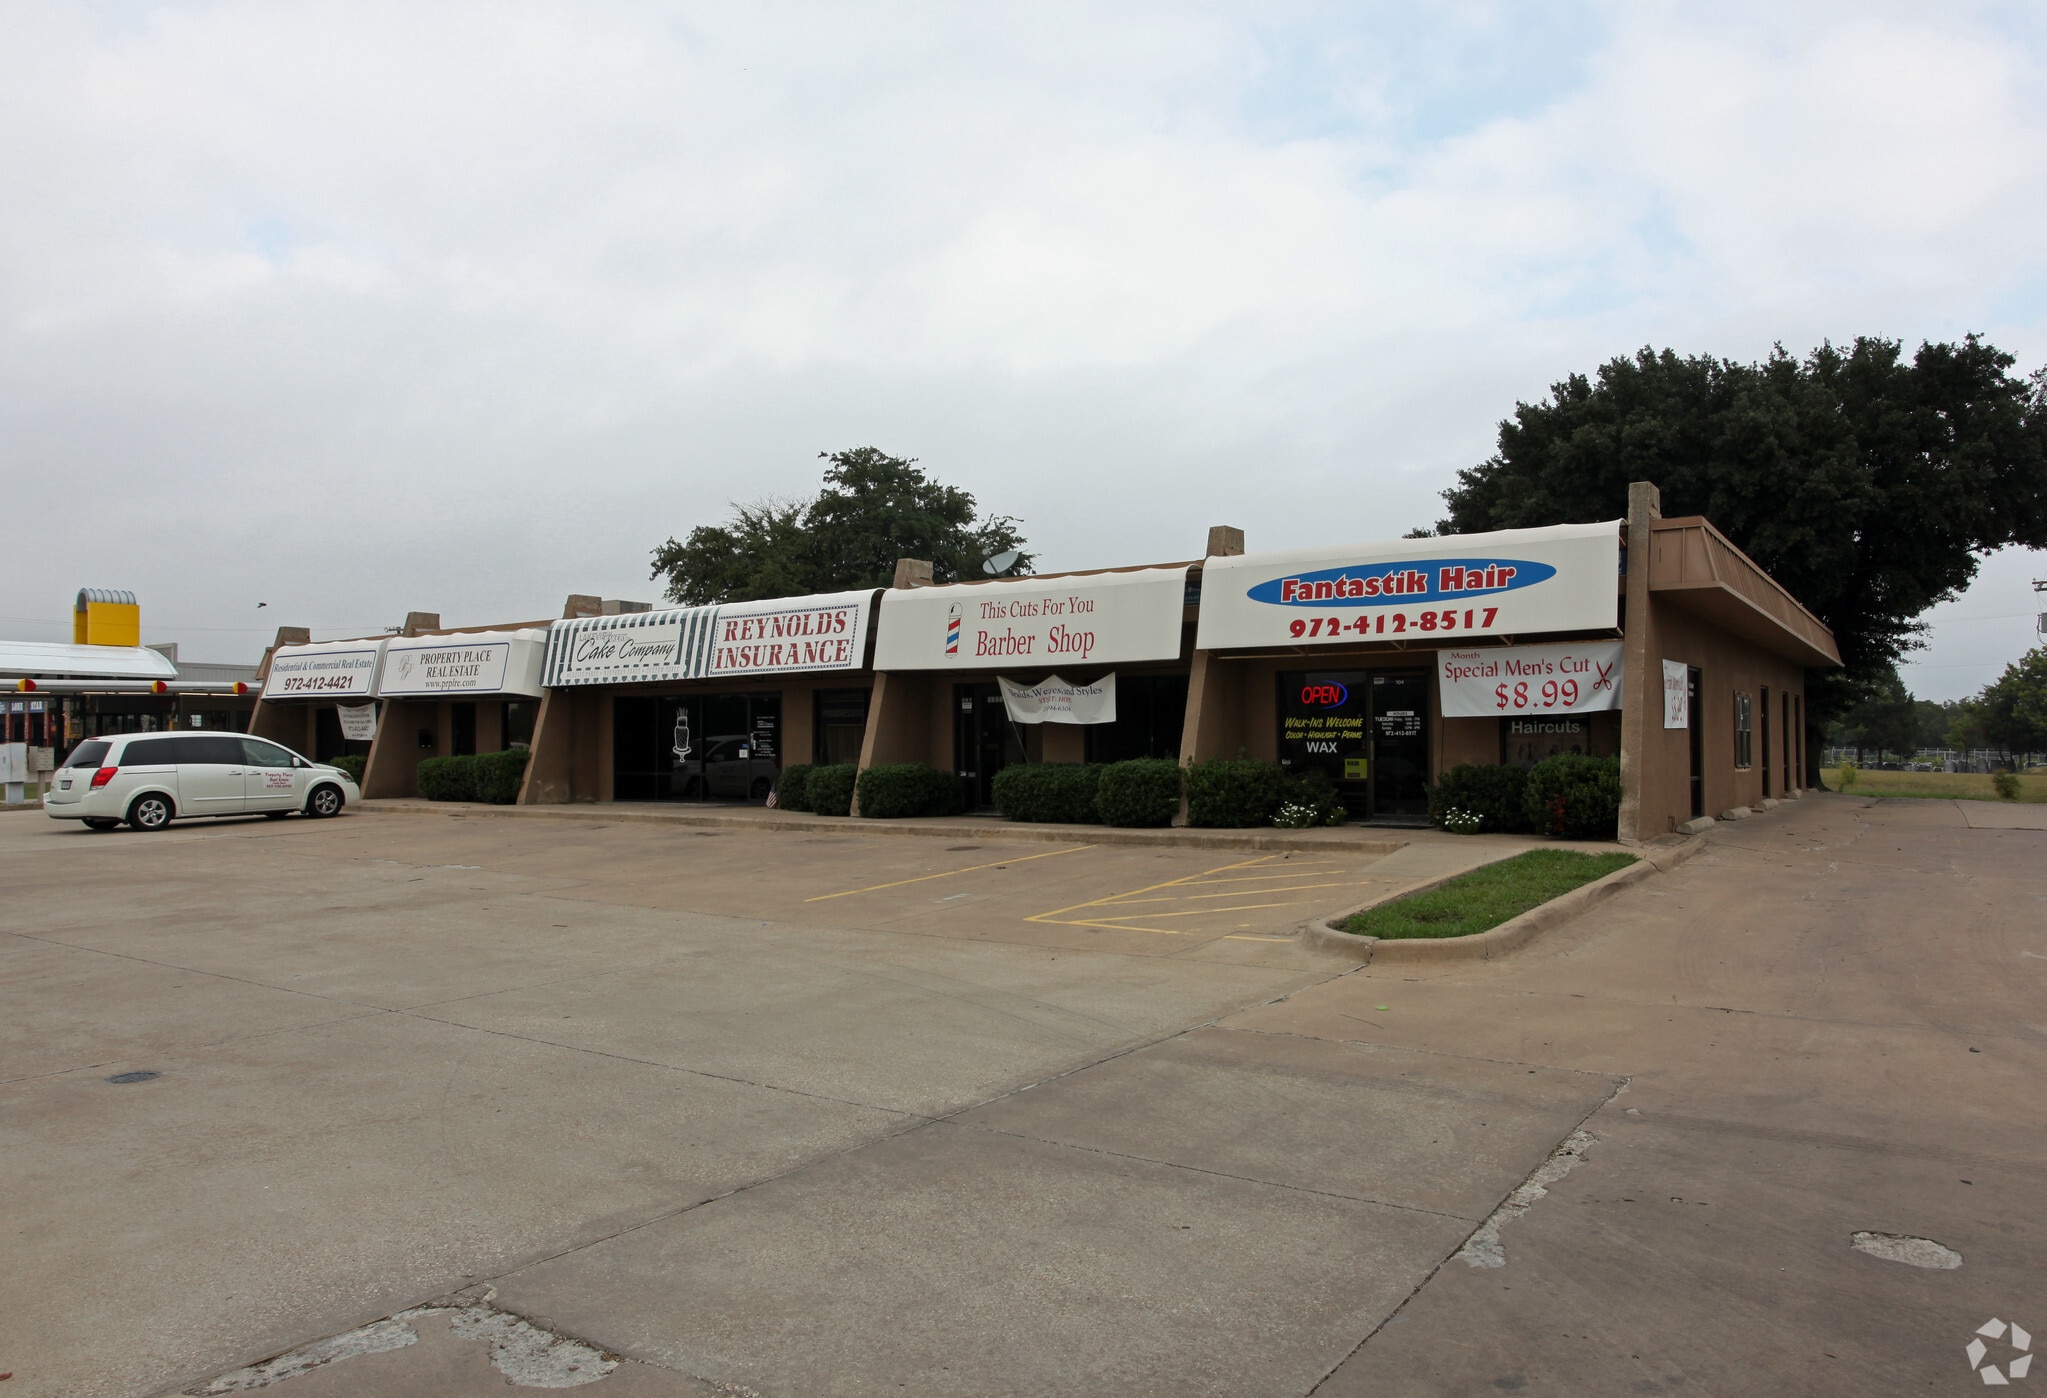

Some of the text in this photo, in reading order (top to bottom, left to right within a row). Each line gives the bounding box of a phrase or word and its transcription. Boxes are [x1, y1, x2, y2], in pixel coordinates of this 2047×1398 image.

[1281, 563, 1517, 603] Fantastik Hair
[980, 597, 1094, 619] This Cuts For You
[723, 610, 847, 642] REYNOLDS
[1289, 607, 1499, 639] 972-412-8517
[577, 638, 676, 662] Cake Company
[975, 624, 1095, 659] Barber Shop
[420, 650, 492, 665] PROPERTY PLACE
[714, 639, 850, 669] INSURANCE
[1451, 652, 1480, 660] Month
[274, 658, 373, 672] Residential & Commercial Real Estate
[426, 664, 480, 678] REAL ESTATE
[1445, 656, 1591, 683] Special Men's Cut
[284, 675, 354, 690] 972-412-4421
[1076, 685, 1103, 698] Styles
[1301, 686, 1340, 704] OPEN
[1495, 678, 1579, 710] $8.99
[1511, 720, 1581, 734] Haircuts
[1306, 741, 1338, 753] WAX
